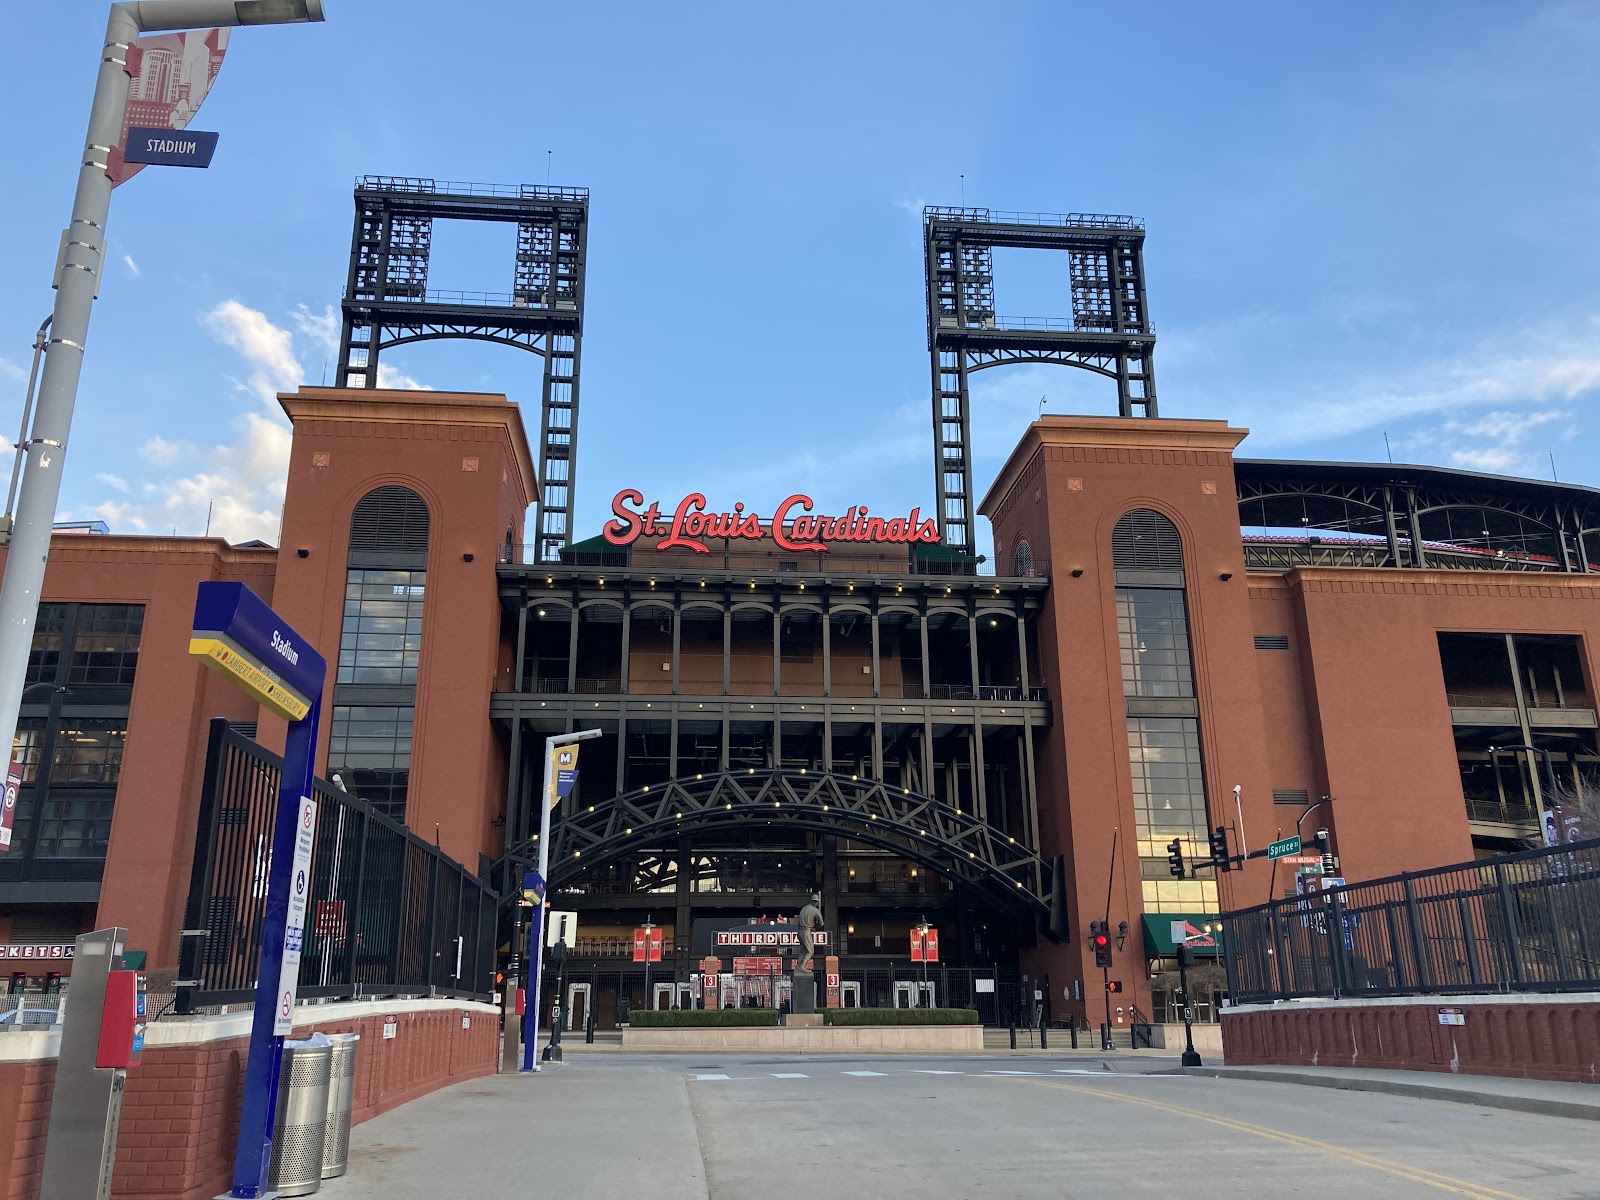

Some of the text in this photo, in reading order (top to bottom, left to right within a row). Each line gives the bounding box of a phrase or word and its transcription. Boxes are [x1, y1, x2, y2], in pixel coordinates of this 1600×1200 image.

[146, 139, 197, 155] STADIUM
[603, 488, 942, 557] St. Louis Cardinals
[270, 629, 299, 666] Stadium
[224, 653, 300, 714] LAMBERT AIRPORT SHREWSBURY
[1270, 842, 1294, 856] Spruce
[720, 934, 823, 943] THIRD BAE
[708, 976, 713, 986] 3
[830, 976, 835, 985] 3
